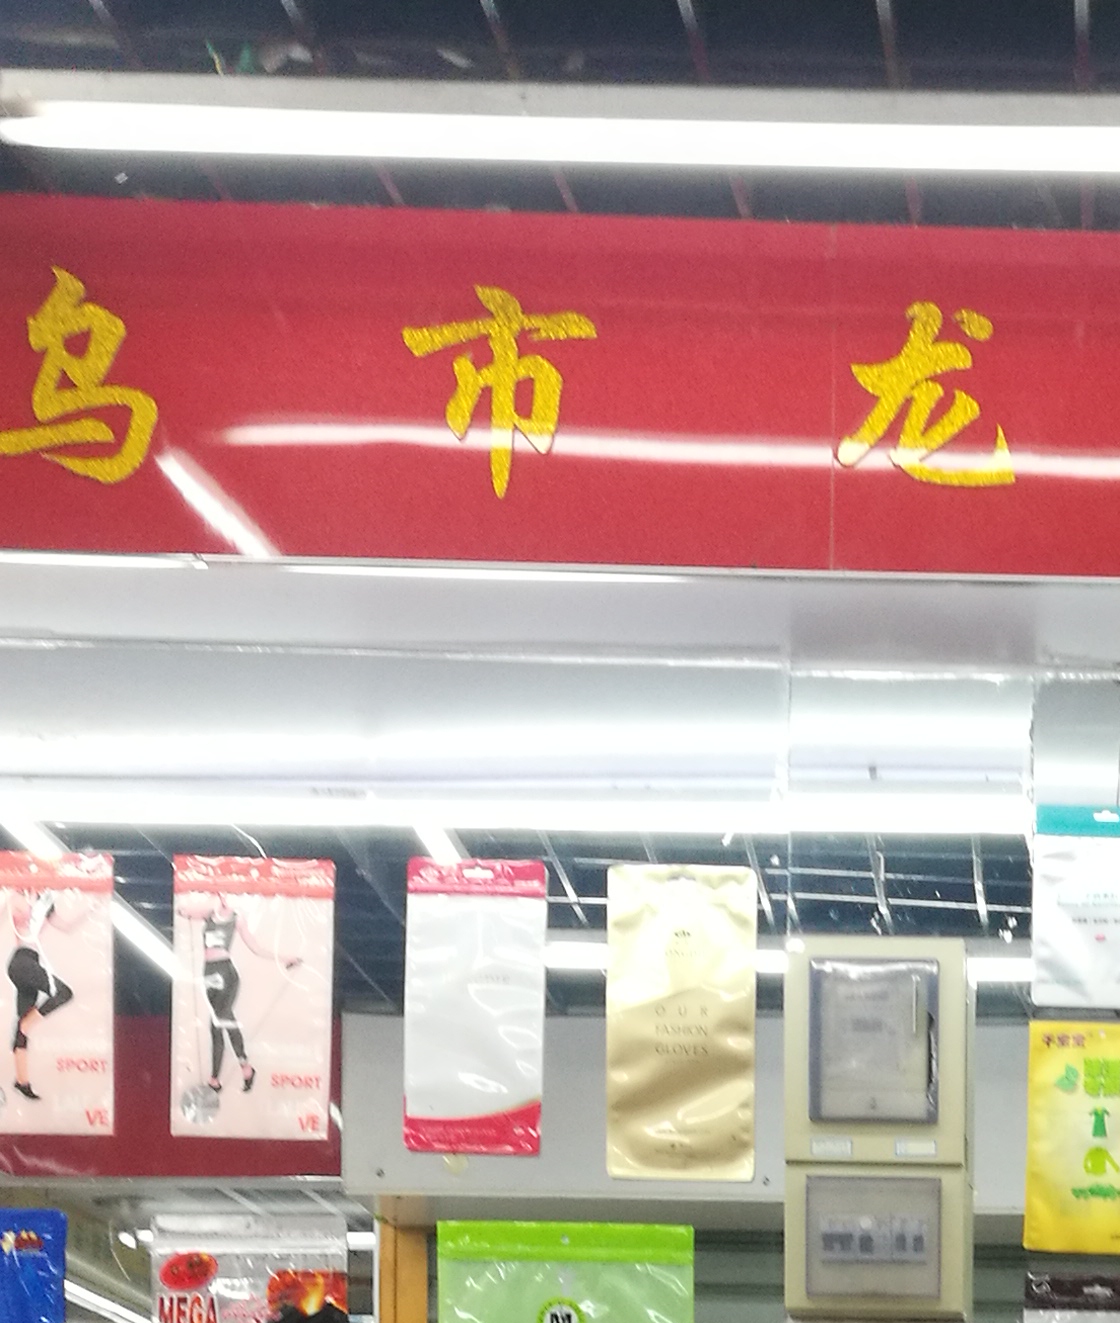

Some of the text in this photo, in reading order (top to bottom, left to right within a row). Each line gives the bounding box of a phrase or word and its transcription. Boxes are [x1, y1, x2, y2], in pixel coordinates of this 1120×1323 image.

[654, 1003, 709, 1017] OUR
[654, 1024, 709, 1037] FASHION
[654, 1043, 709, 1056] GLOVES
[56, 1056, 108, 1074] SPORT
[270, 1073, 322, 1090] SPORT
